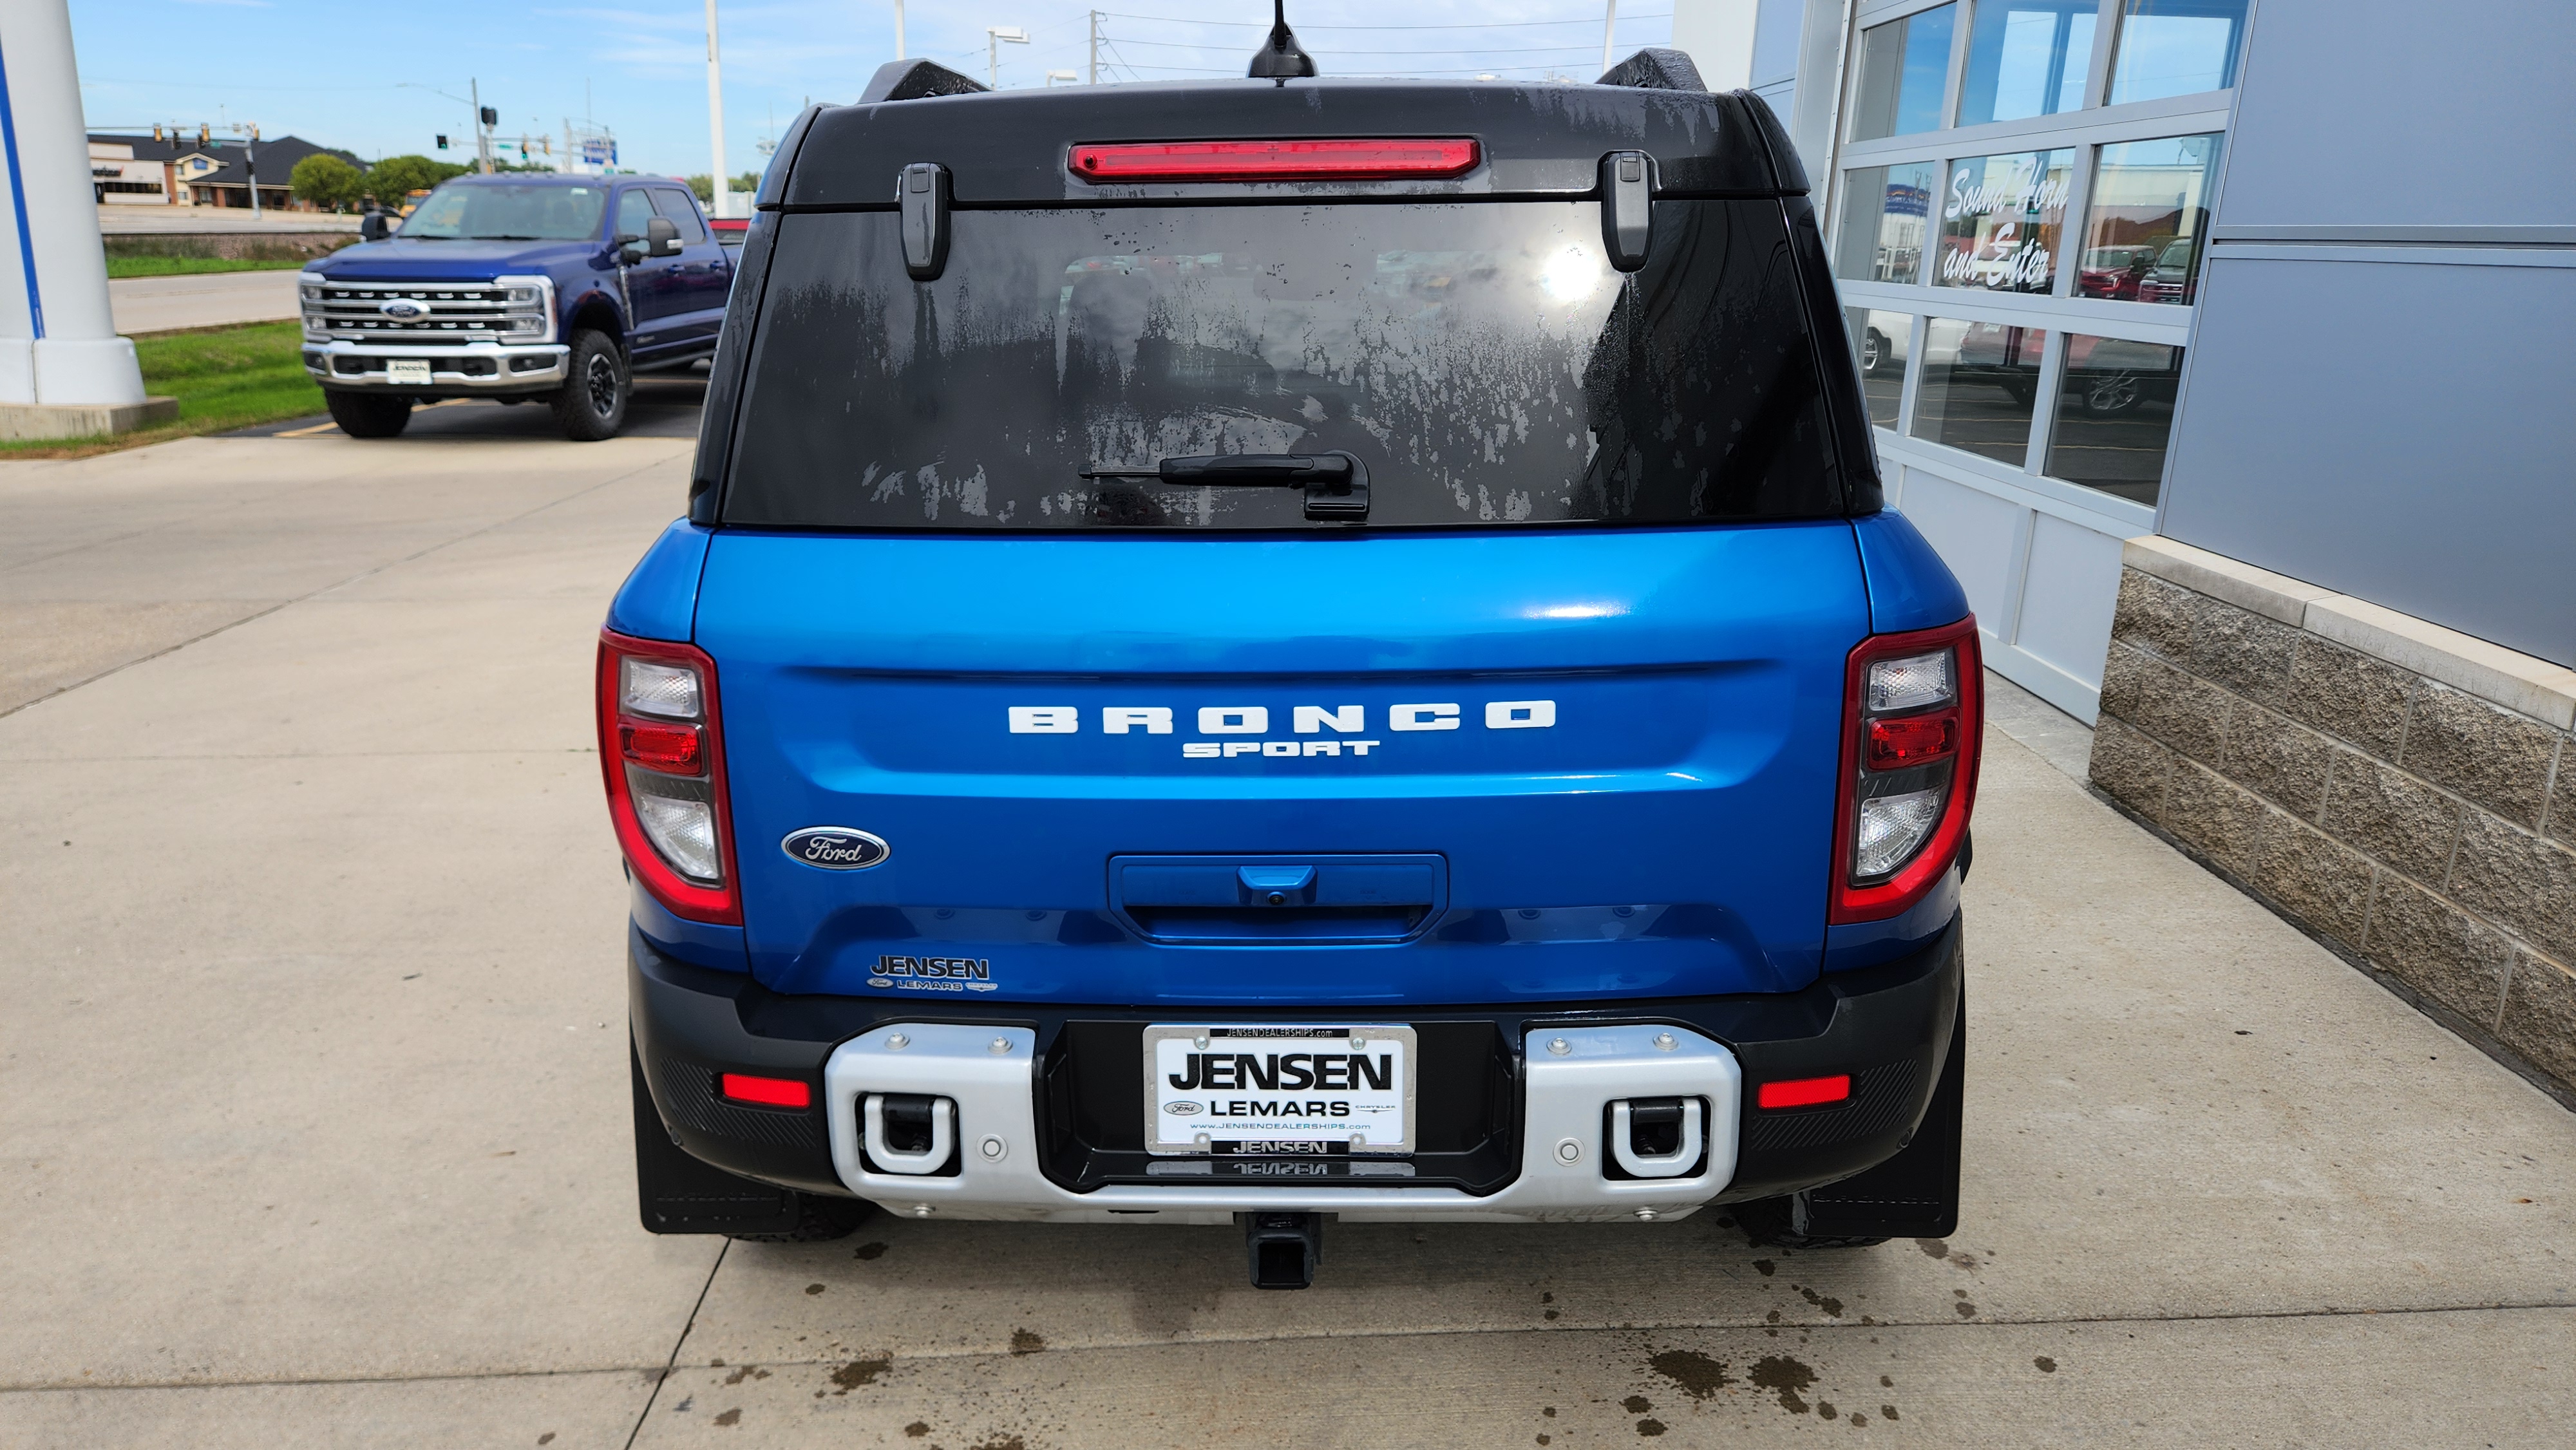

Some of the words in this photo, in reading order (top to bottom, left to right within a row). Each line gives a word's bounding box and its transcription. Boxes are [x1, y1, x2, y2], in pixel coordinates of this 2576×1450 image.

[1945, 168, 2013, 218] Sound
[2014, 156, 2070, 213] Horn
[1944, 231, 1987, 281] and
[1986, 222, 2050, 287] Enter
[1009, 700, 1556, 734] BRONCO
[1182, 740, 1380, 758] SPORT
[805, 836, 862, 861] Ford
[871, 956, 989, 980] JENSEN
[897, 980, 963, 991] LEMARS
[1227, 1028, 1333, 1037] JENSENDEALERSHIPS.com
[1169, 1053, 1392, 1090] JENSEN
[1211, 1101, 1350, 1116] LEMARS
[1233, 1142, 1327, 1154] JENSEN
